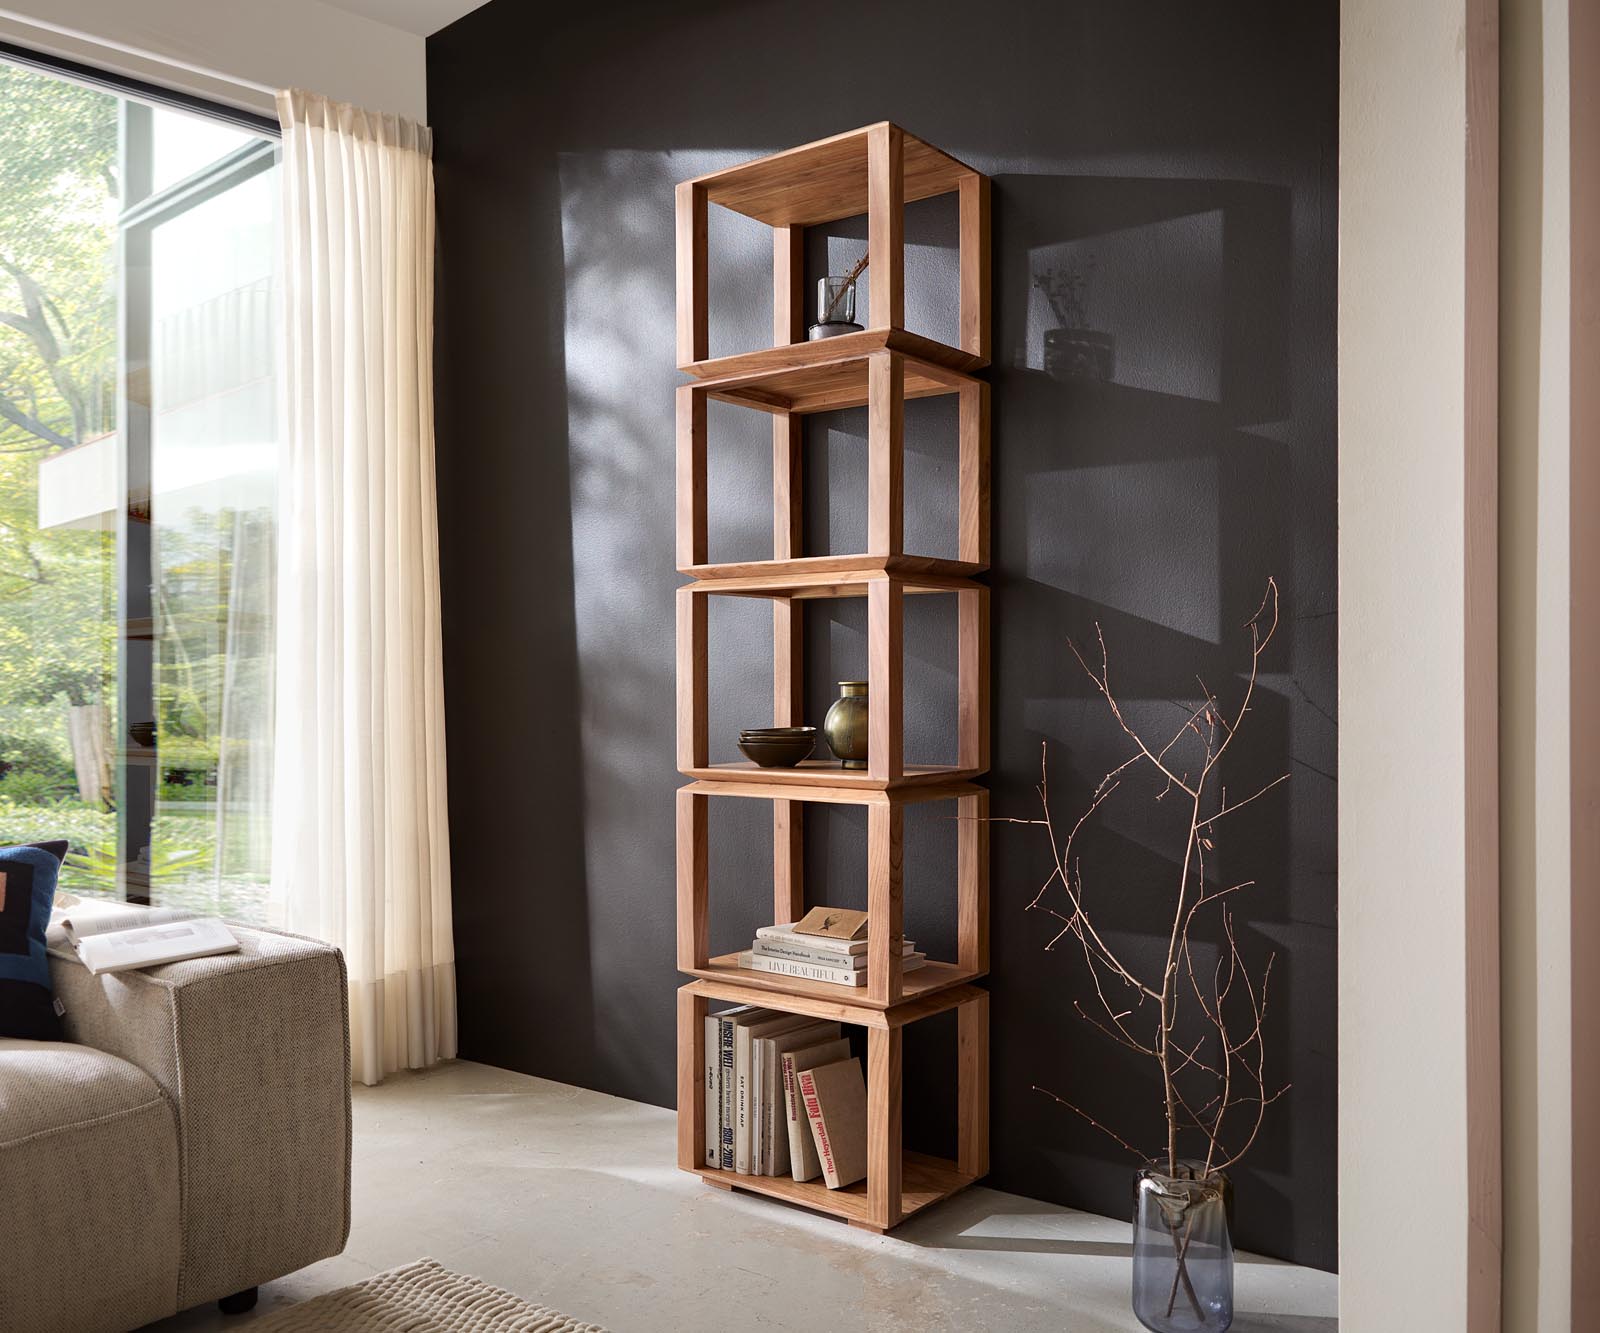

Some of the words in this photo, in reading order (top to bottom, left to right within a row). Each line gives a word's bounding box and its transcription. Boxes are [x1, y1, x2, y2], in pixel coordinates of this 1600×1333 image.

[769, 961, 787, 973] LIVE
[789, 964, 837, 981] BEAUTIFUL
[723, 1021, 733, 1049] UNSERE
[723, 1050, 733, 1069] WELT
[801, 1074, 814, 1095] Hiva
[723, 1128, 733, 1168] 1800-2000
[816, 1122, 830, 1157] Heyerdahl
